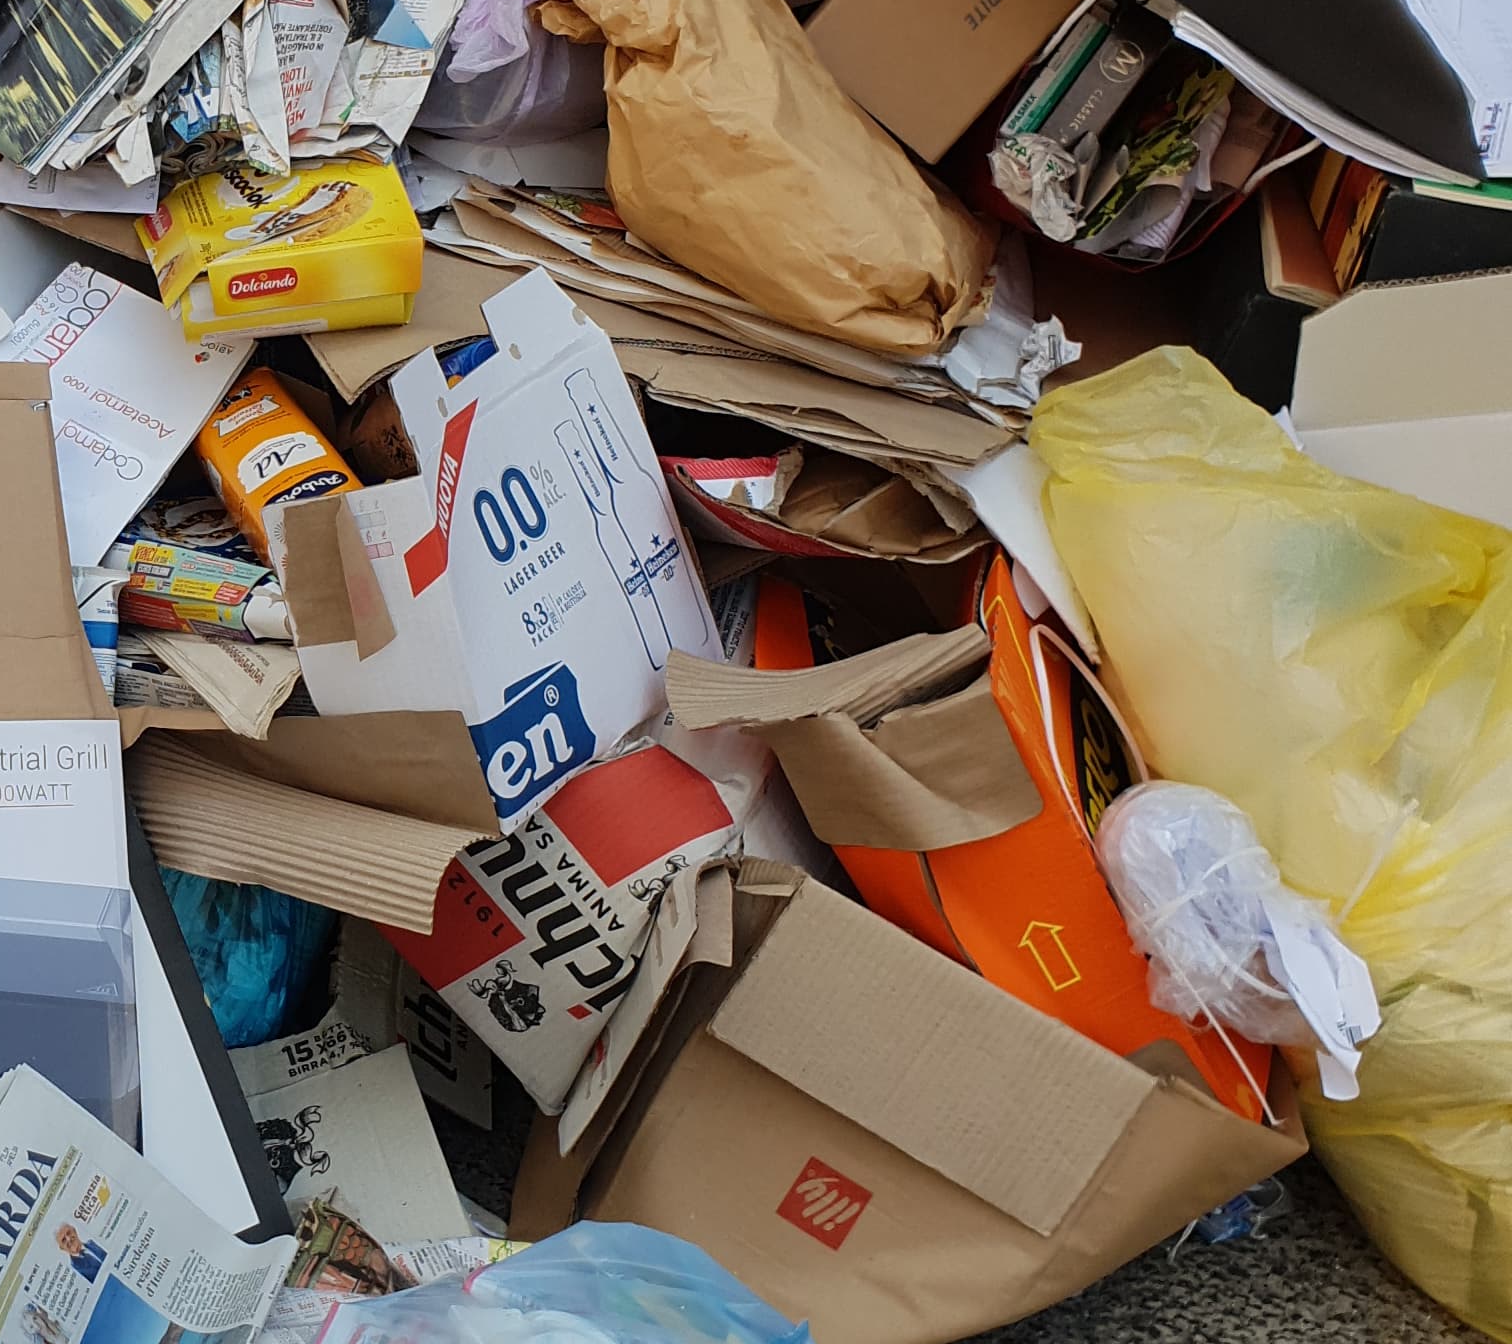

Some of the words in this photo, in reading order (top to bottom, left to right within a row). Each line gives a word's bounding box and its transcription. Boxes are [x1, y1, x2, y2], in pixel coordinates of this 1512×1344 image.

[1069, 88, 1104, 132] CLASSIC
[231, 273, 296, 295] Dolciando
[63, 374, 89, 393] 1000
[90, 388, 175, 439] Acetamol
[55, 418, 144, 481] Codamol
[438, 451, 461, 537] NUOVA
[472, 465, 548, 564] 0.0
[503, 560, 539, 597] LAGER
[539, 541, 567, 572] BEER
[56, 745, 109, 771] Grill
[448, 871, 505, 937] 1912
[557, 852, 625, 932] ANIMA
[281, 1039, 312, 1067] 15
[288, 1059, 329, 1078] BIRRA
[71, 1173, 104, 1220] Garanzia
[78, 1194, 100, 1222] Etica
[794, 1174, 861, 1232] illy
[122, 1226, 156, 1279] Sardegna
[135, 1251, 158, 1292] regina
[146, 1256, 172, 1298] d'Italia
